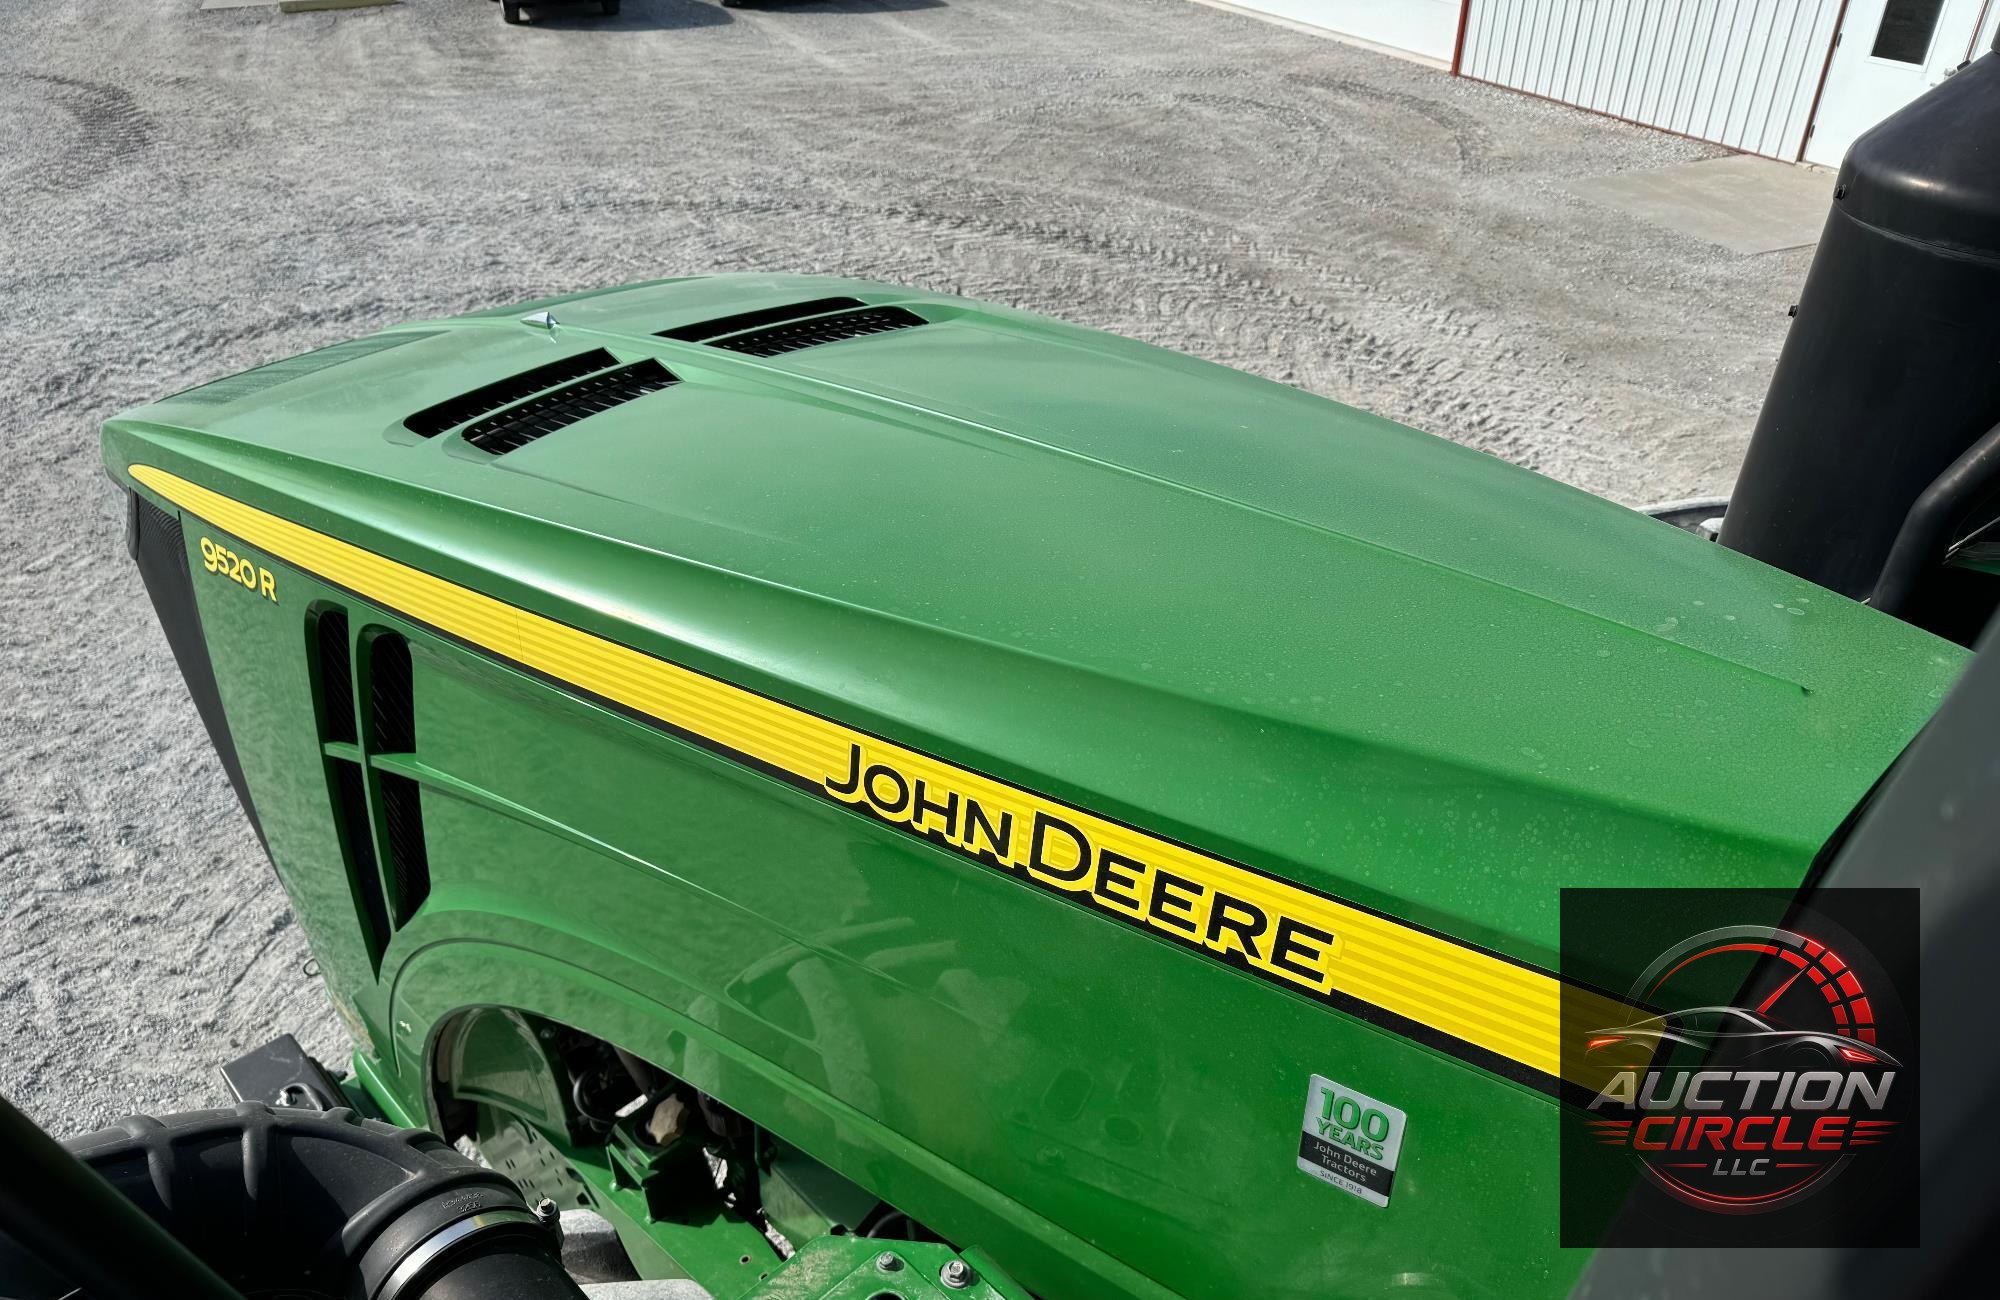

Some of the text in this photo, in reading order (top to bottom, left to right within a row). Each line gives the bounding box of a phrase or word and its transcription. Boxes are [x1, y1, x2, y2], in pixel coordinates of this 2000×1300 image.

[200, 536, 278, 604] 9520 R
[824, 743, 1336, 985] JOHN DEERE
[1320, 1087, 1390, 1143] 100
[1313, 1141, 1378, 1177] John Deere
[1316, 1117, 1384, 1161] YEARS
[1321, 1154, 1367, 1183] Tractors
[1345, 1182, 1363, 1195] 1918
